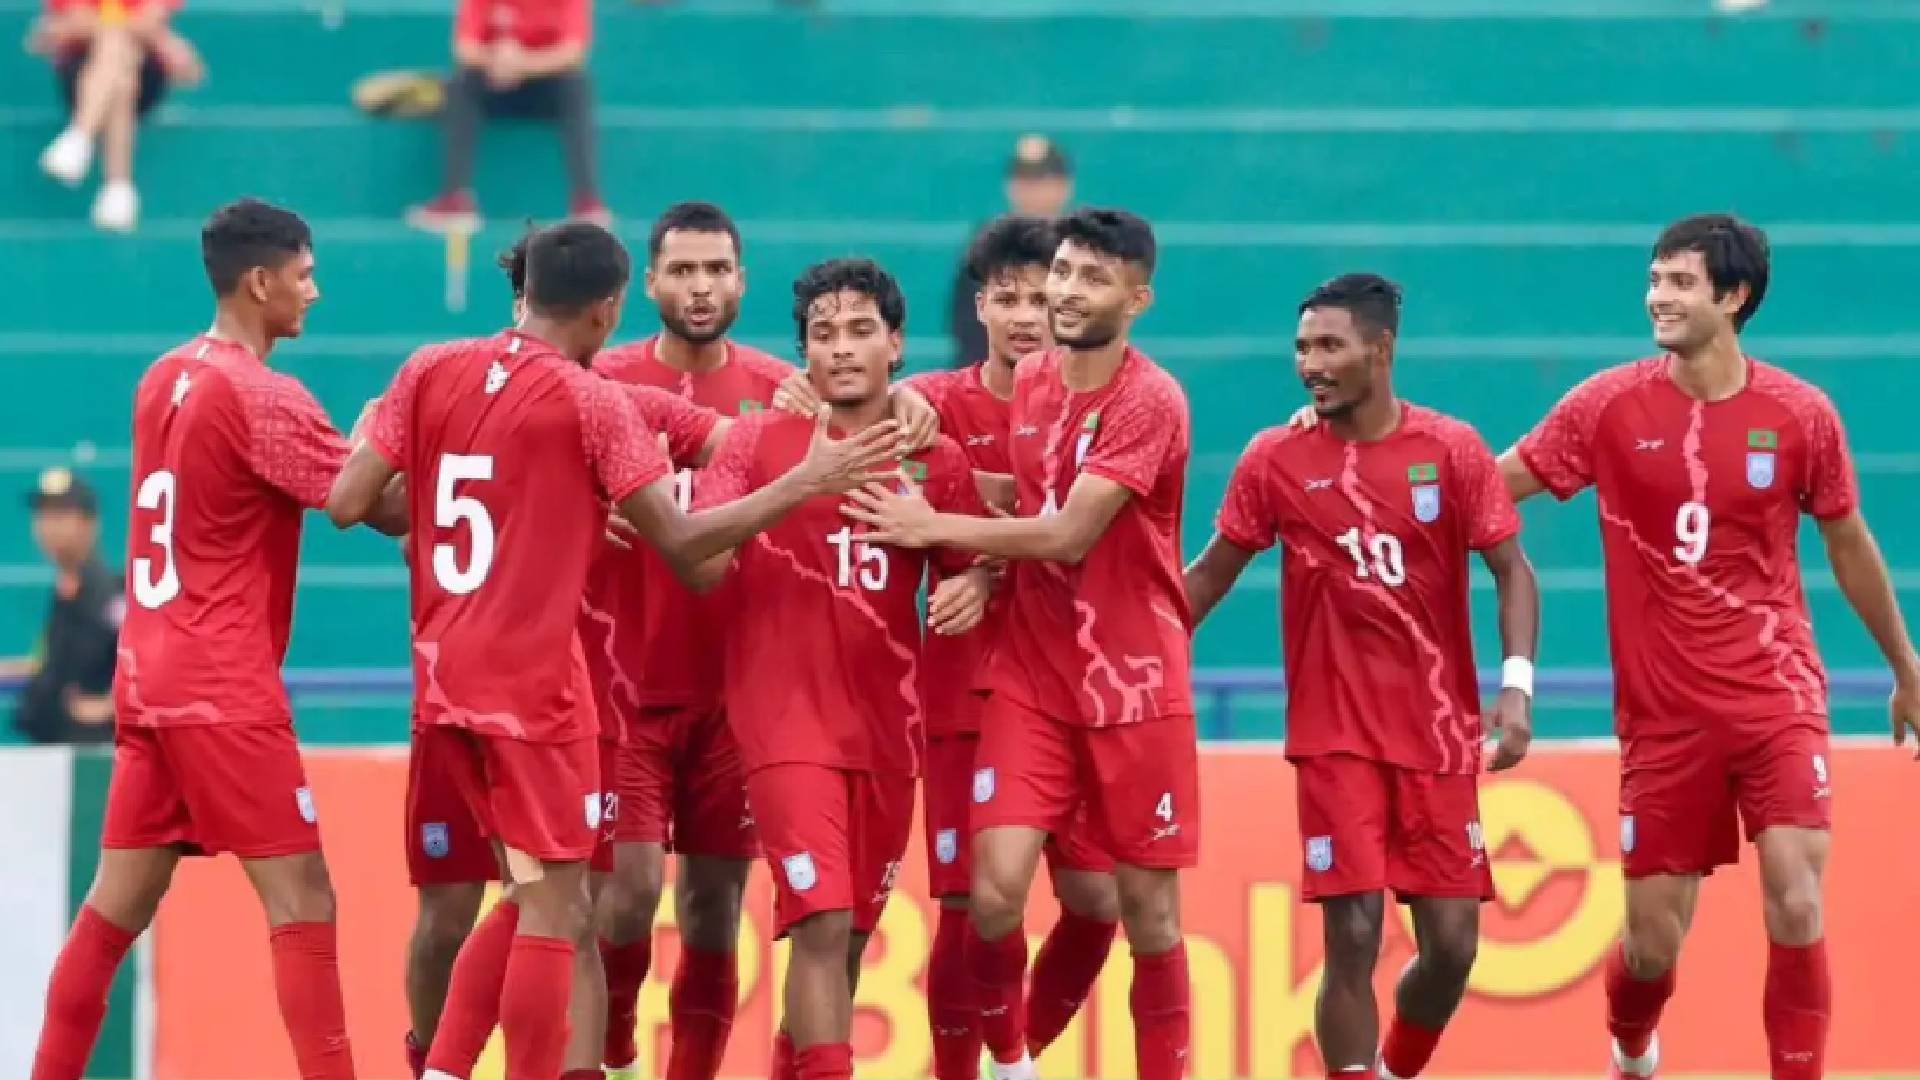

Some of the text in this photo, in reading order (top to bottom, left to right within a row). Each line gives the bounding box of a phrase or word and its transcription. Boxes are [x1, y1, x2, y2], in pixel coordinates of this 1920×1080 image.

[132, 470, 181, 609] 3
[433, 453, 494, 595] 5
[1673, 501, 1709, 564] 9
[826, 526, 889, 591] 15
[1335, 526, 1405, 586] 10
[1812, 753, 1827, 783] 9
[1155, 791, 1173, 822] 4
